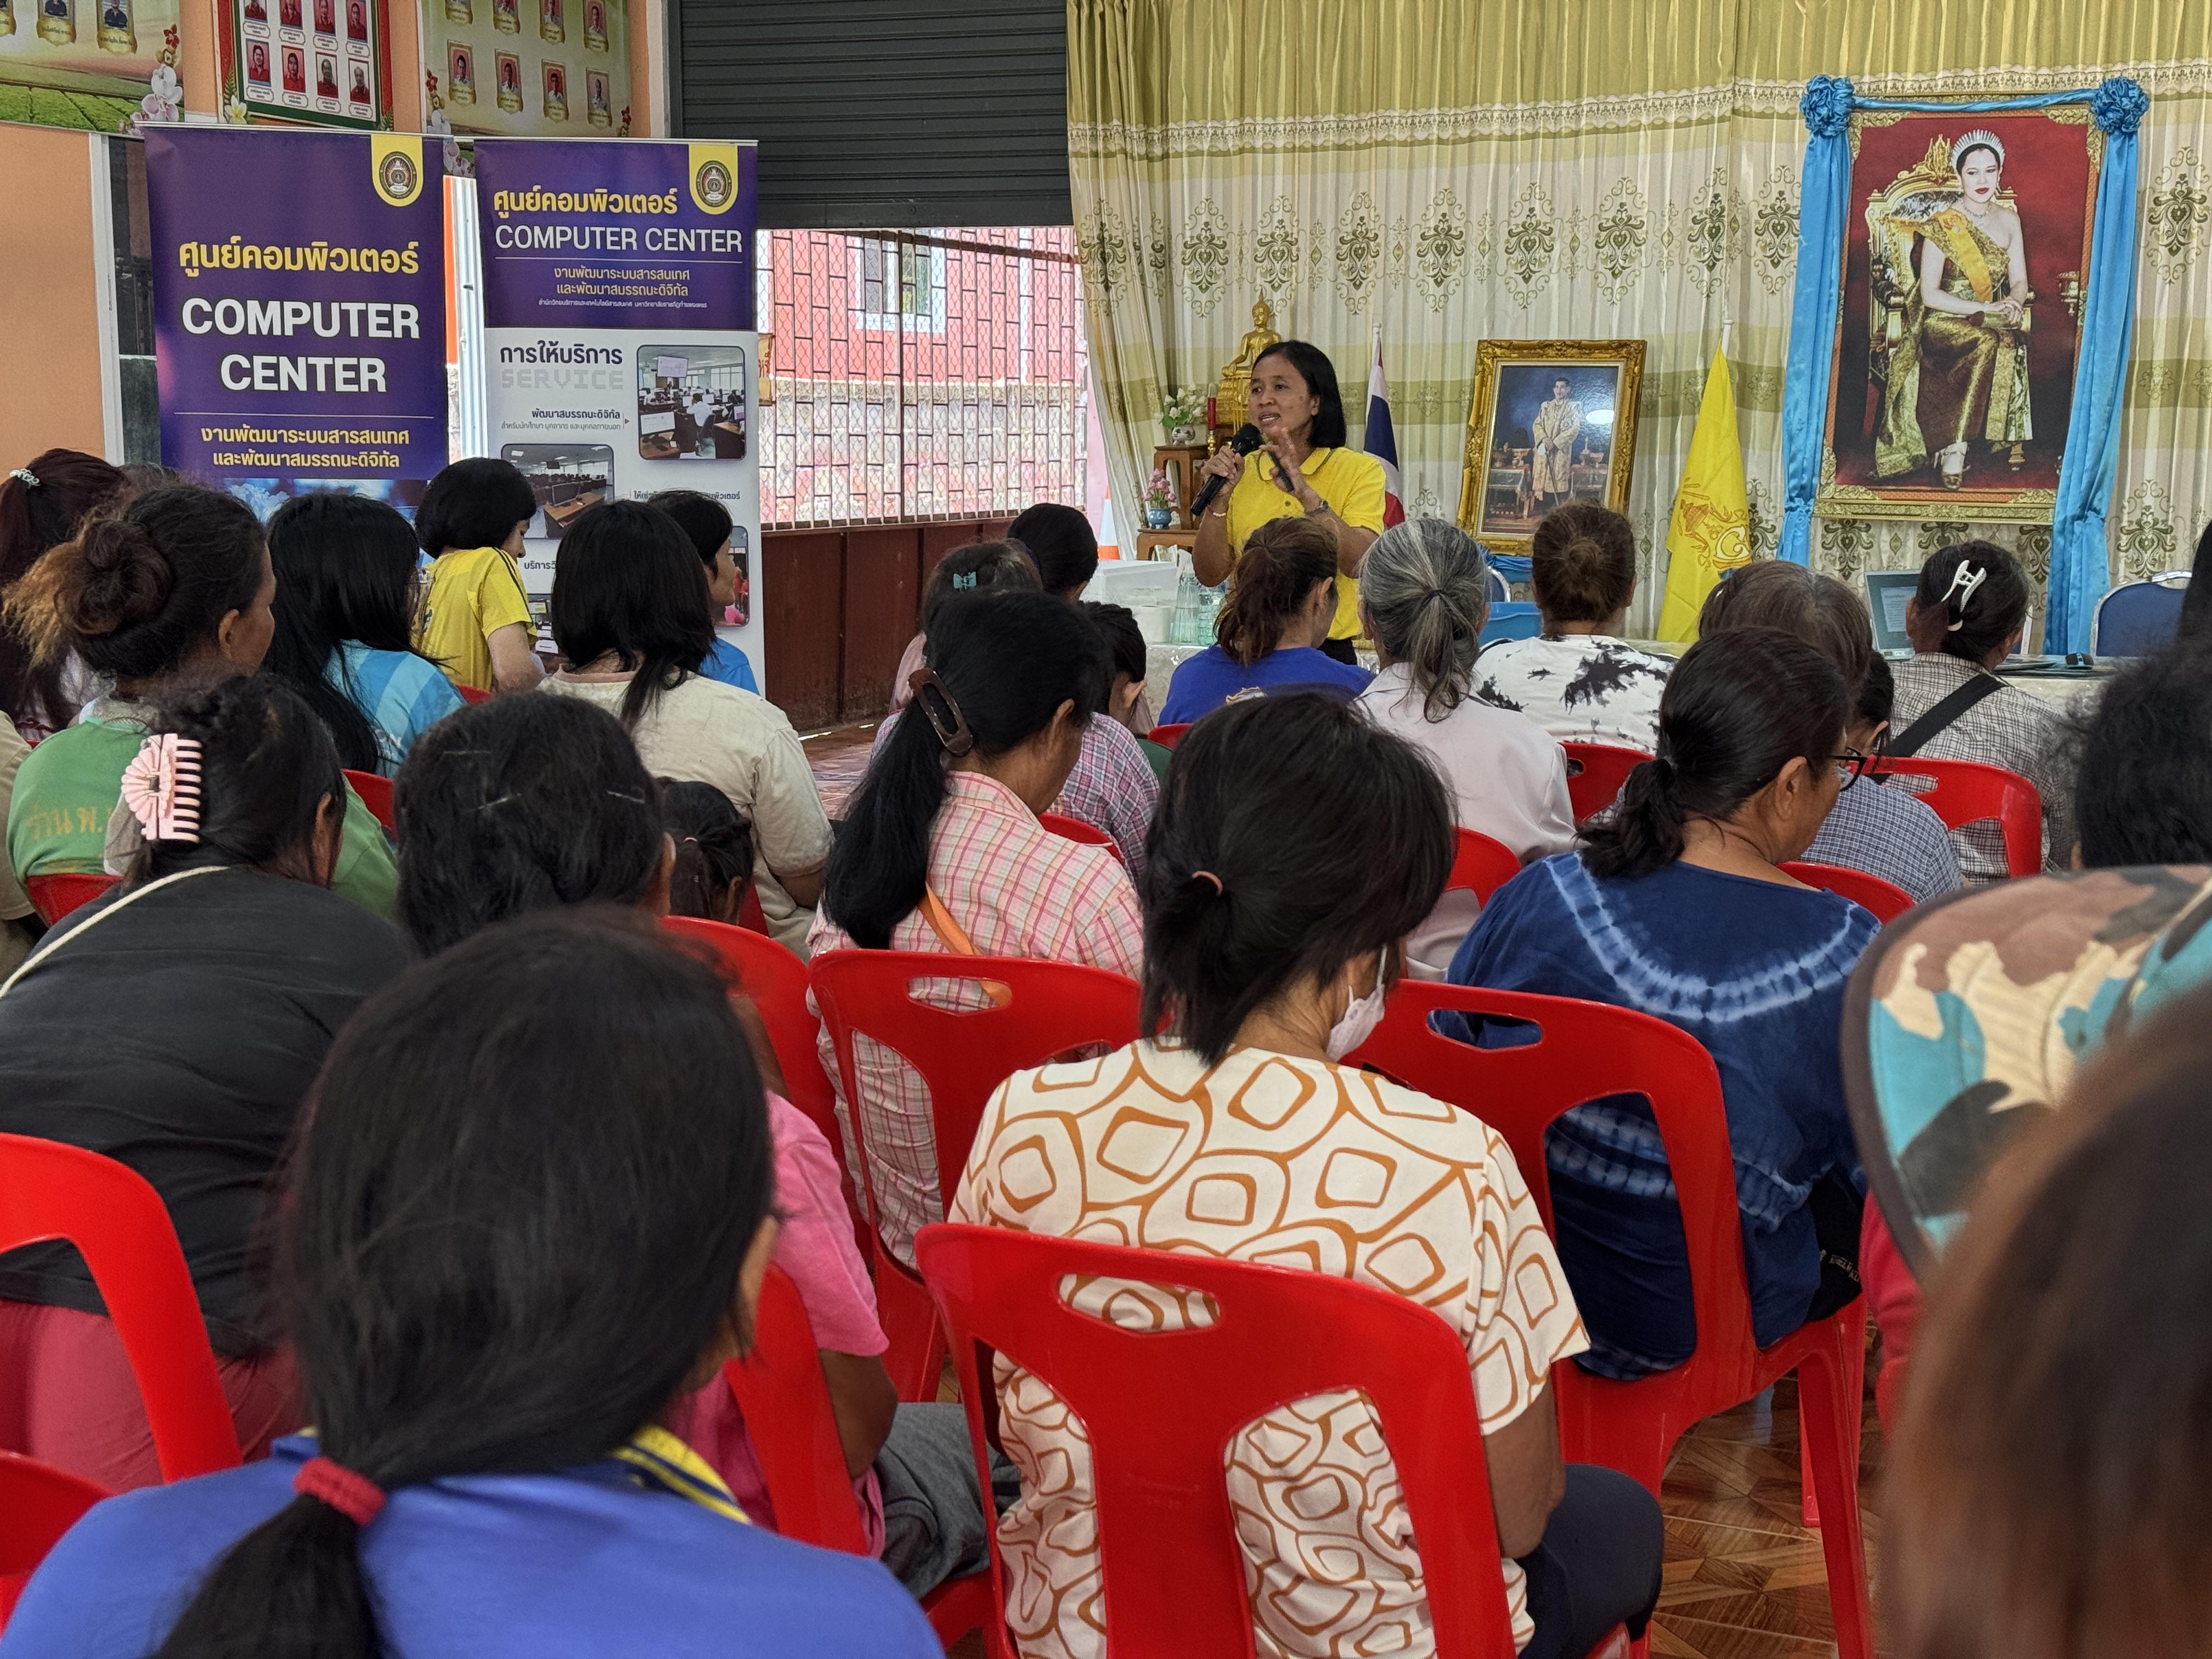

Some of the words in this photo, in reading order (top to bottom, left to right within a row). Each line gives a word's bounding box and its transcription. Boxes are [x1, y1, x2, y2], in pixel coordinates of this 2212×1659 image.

[494, 185, 678, 218] ศูนย์คอมพิวเตอร์
[495, 224, 638, 251] COMPUTER
[645, 227, 743, 253] CENTER
[179, 235, 419, 277] ศูนย์คอมพิวเตอร์
[554, 265, 690, 281] งานพัฒนาระบบสารสนเทศ
[557, 281, 689, 296] และพัฒนาสมรรถนะดิจิทัล
[182, 297, 420, 339] COMPUTER
[500, 340, 623, 364] การให้บริการ
[221, 354, 387, 392] CENTER
[501, 369, 624, 390] SERVICE
[532, 408, 620, 419] พัฒนาสมรรถนะดิจิทัล
[201, 424, 409, 445] งานพัฒนาระบบสารสนเทศ
[213, 449, 400, 469] และพัฒนาสมรรถนะดิจิทัล
